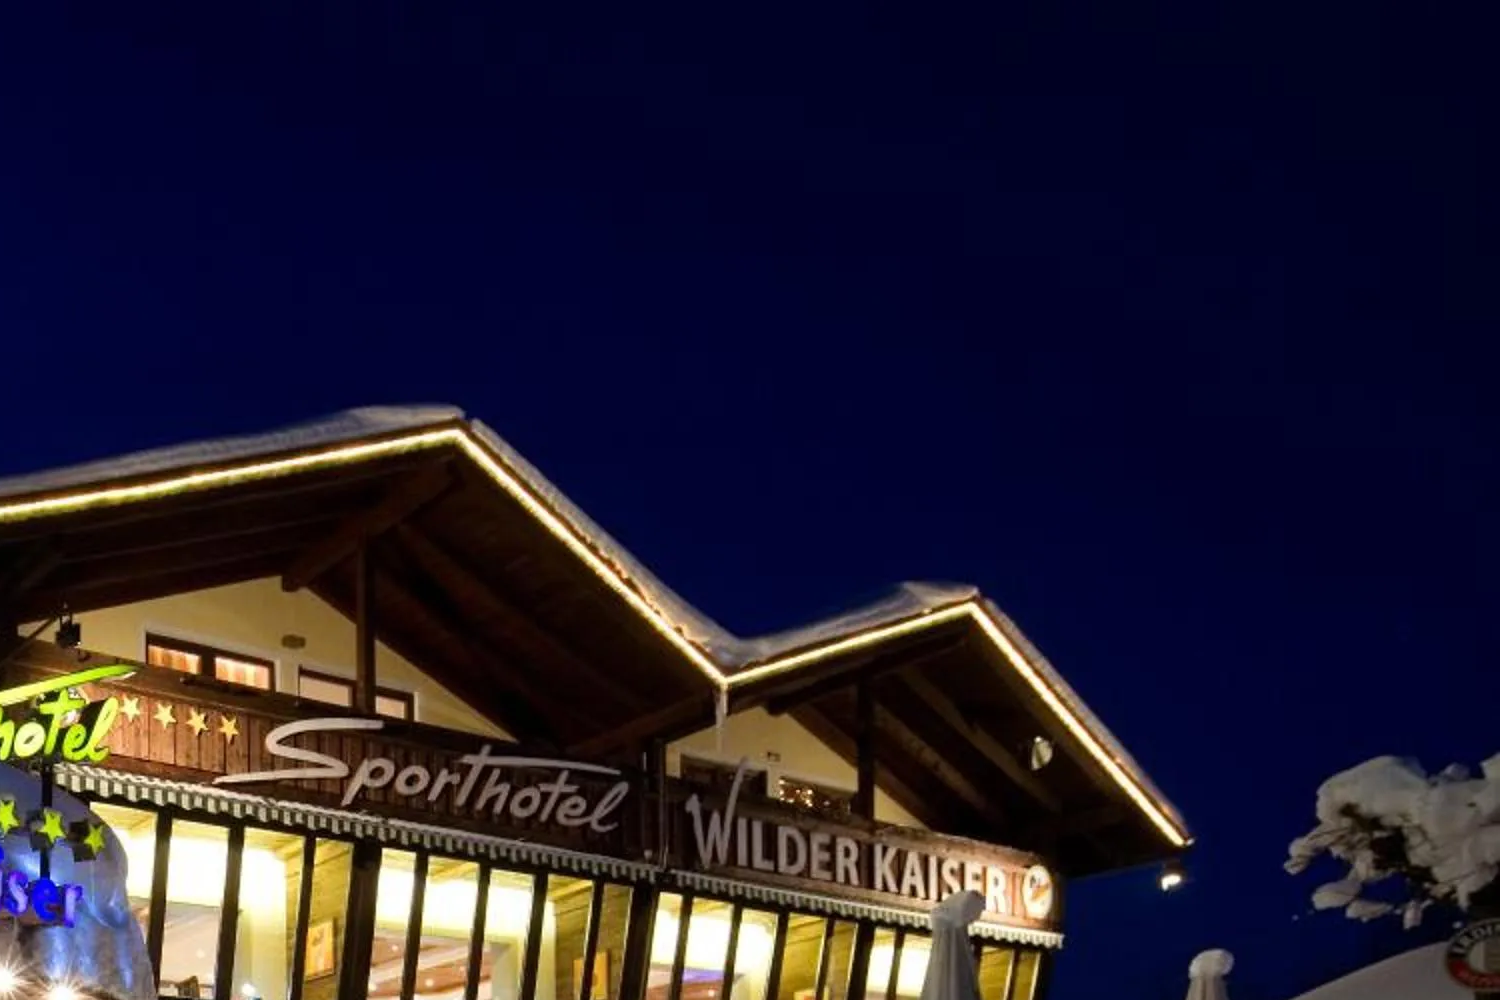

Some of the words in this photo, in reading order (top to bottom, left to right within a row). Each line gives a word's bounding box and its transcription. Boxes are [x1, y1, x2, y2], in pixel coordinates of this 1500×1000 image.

[214, 717, 629, 832] Sporthotel
[686, 756, 861, 886] WILDER
[873, 842, 1008, 915] KAISER
